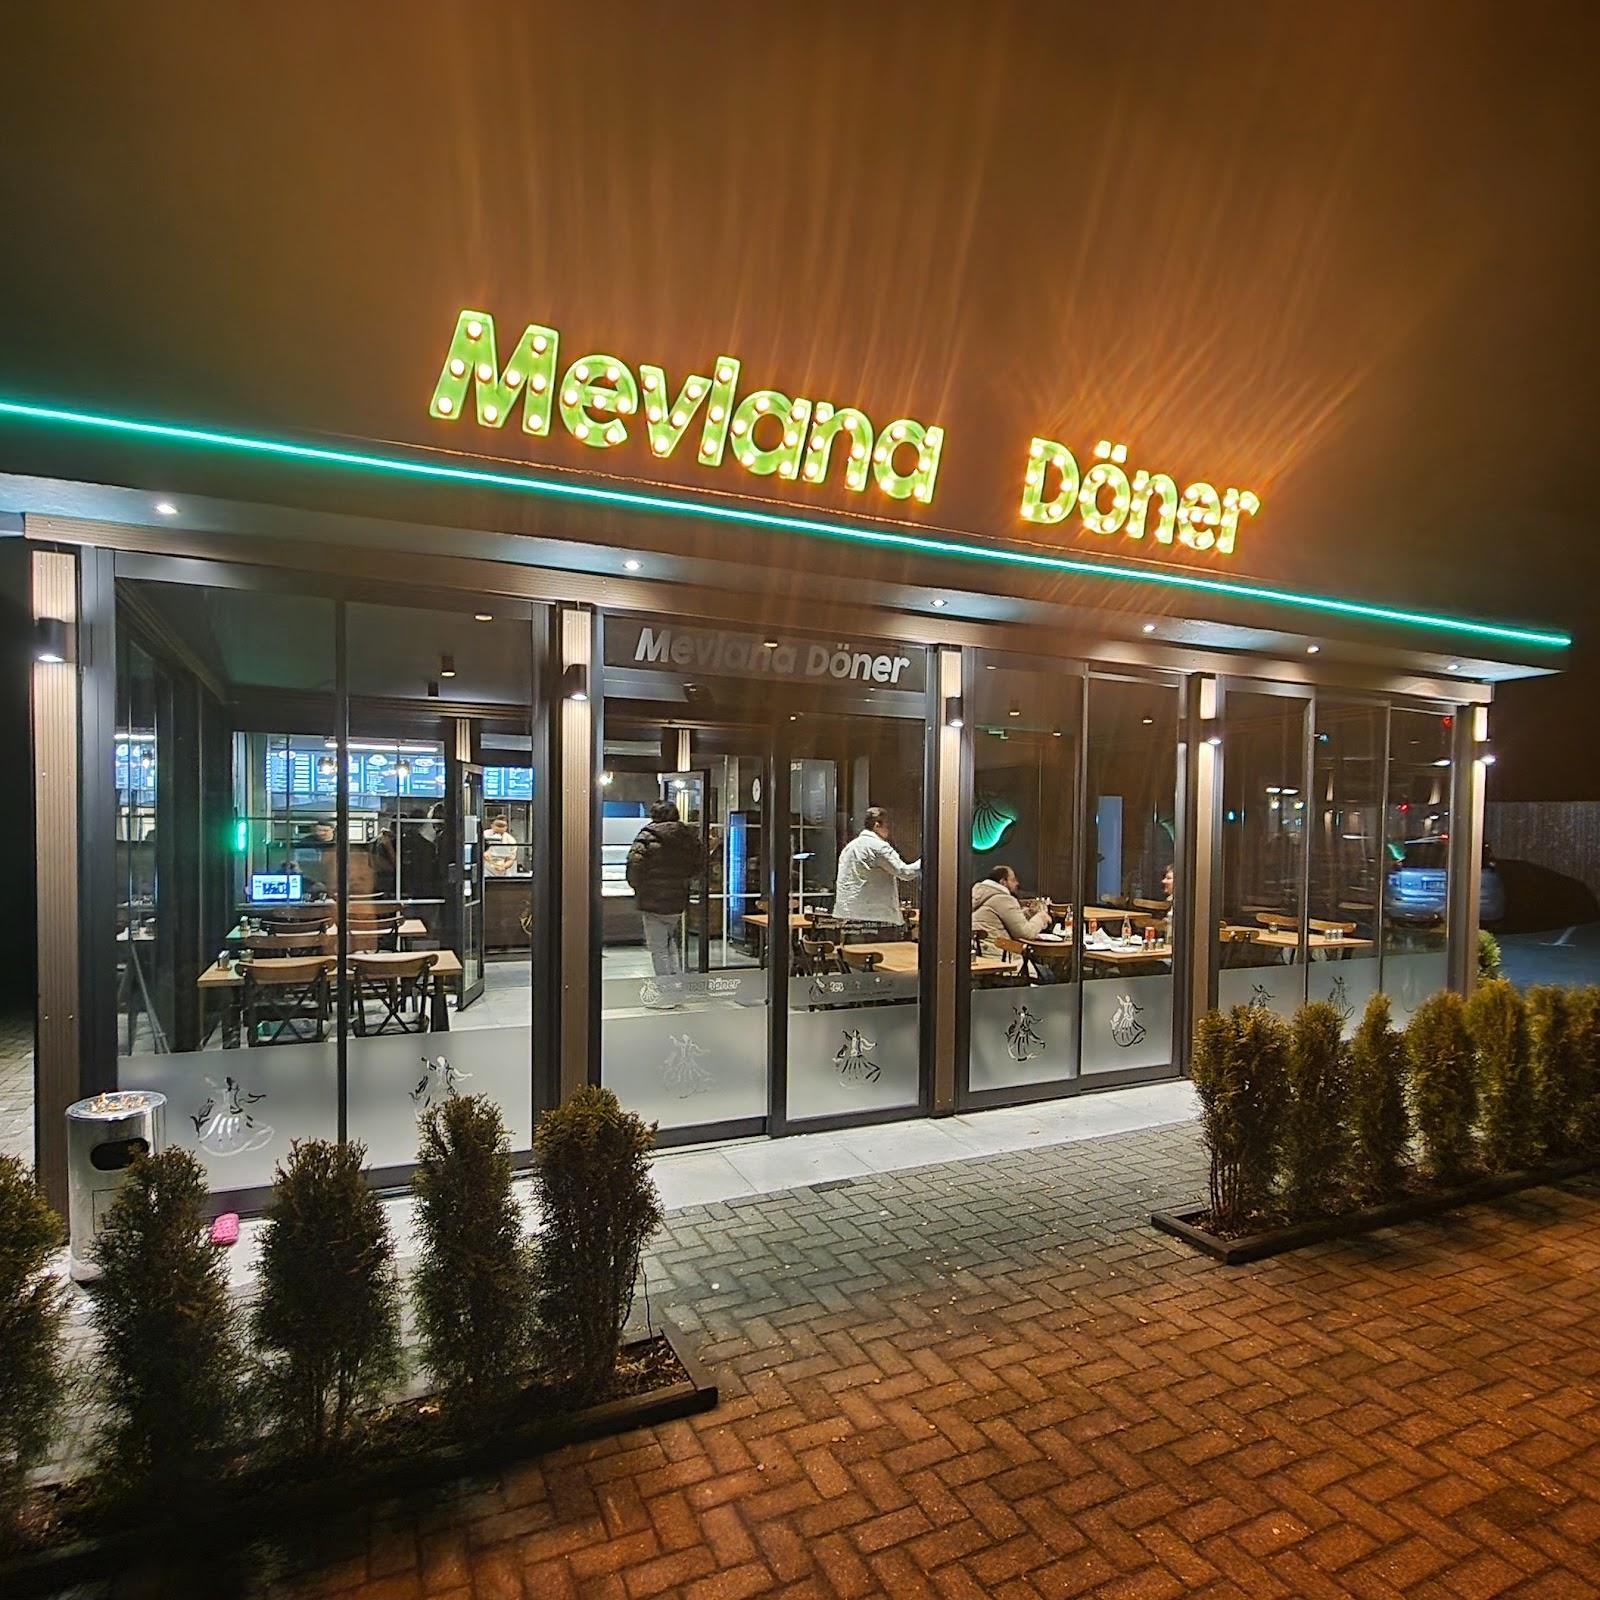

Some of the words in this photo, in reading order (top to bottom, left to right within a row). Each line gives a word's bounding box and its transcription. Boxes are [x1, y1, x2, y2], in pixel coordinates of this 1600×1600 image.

[429, 309, 944, 504] Mevlana
[1020, 437, 1260, 554] Döner
[635, 628, 794, 674] Mevlana
[806, 643, 911, 684] Döner
